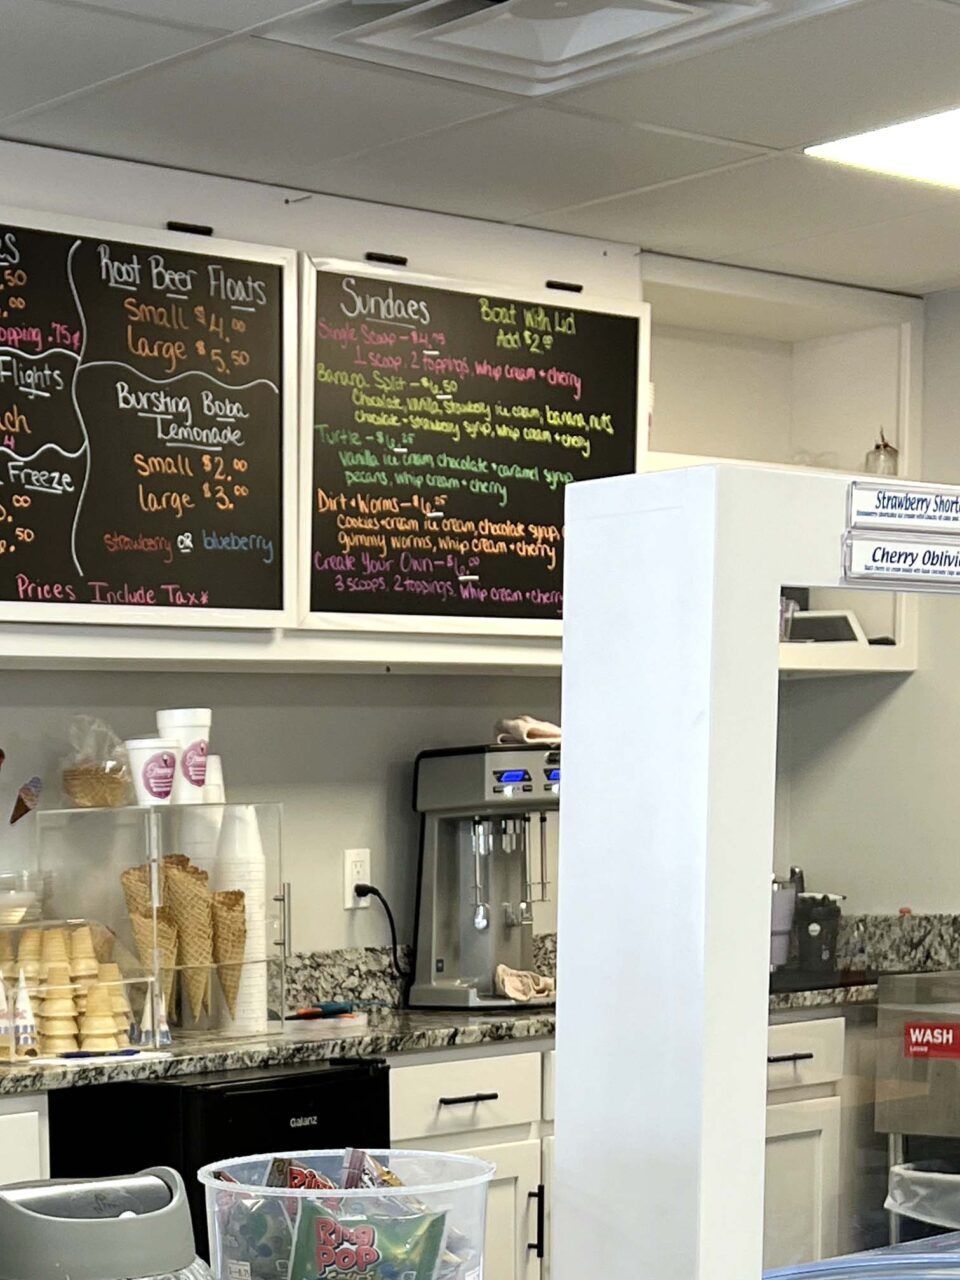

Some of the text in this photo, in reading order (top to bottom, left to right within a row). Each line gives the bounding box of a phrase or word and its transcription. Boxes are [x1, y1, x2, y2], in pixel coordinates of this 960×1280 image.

[98, 244, 266, 305] Root Beer Floats
[340, 277, 430, 325] Sundaes
[479, 297, 576, 335] Boat Lid
[194, 305, 245, 342] $4.00
[496, 328, 521, 348] Add
[195, 341, 250, 375] $5.50
[116, 382, 250, 426] Bursting Boba
[3, 436, 15, 449] 4
[157, 416, 245, 446] Lemonade
[315, 423, 362, 445] Turtle
[7, 462, 75, 492] Freeze
[201, 454, 248, 481] $2.00
[202, 482, 249, 510] $3.00
[317, 488, 347, 513] Dirt
[875, 490, 931, 514] Strawberry
[202, 528, 274, 564] blueberry
[872, 547, 919, 567] Cherry
[314, 551, 433, 575] Create Your Own
[16, 573, 155, 604] Prices Include
[910, 1029, 953, 1044] WASH
[315, 1216, 376, 1248] Ring
